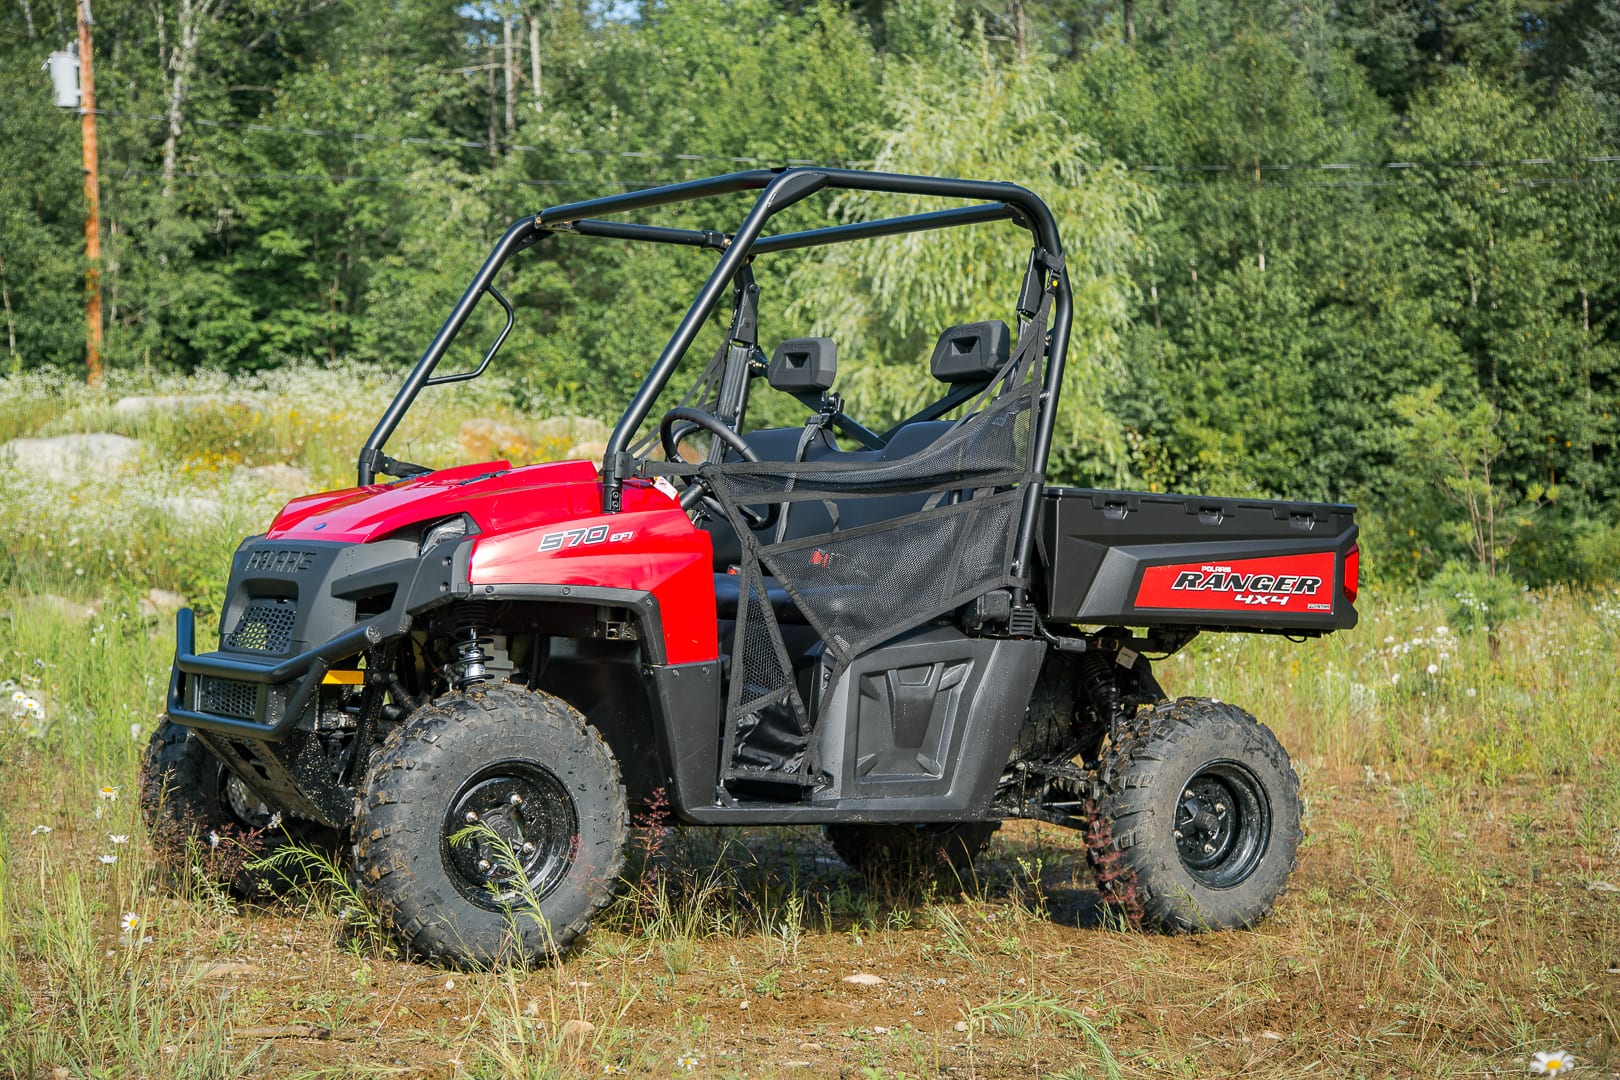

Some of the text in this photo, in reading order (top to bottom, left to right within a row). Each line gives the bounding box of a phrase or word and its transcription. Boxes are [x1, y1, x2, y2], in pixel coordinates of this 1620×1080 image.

[538, 525, 633, 552] 570 EFI
[1171, 571, 1322, 595] RANGER
[1234, 594, 1290, 605] 4X4
